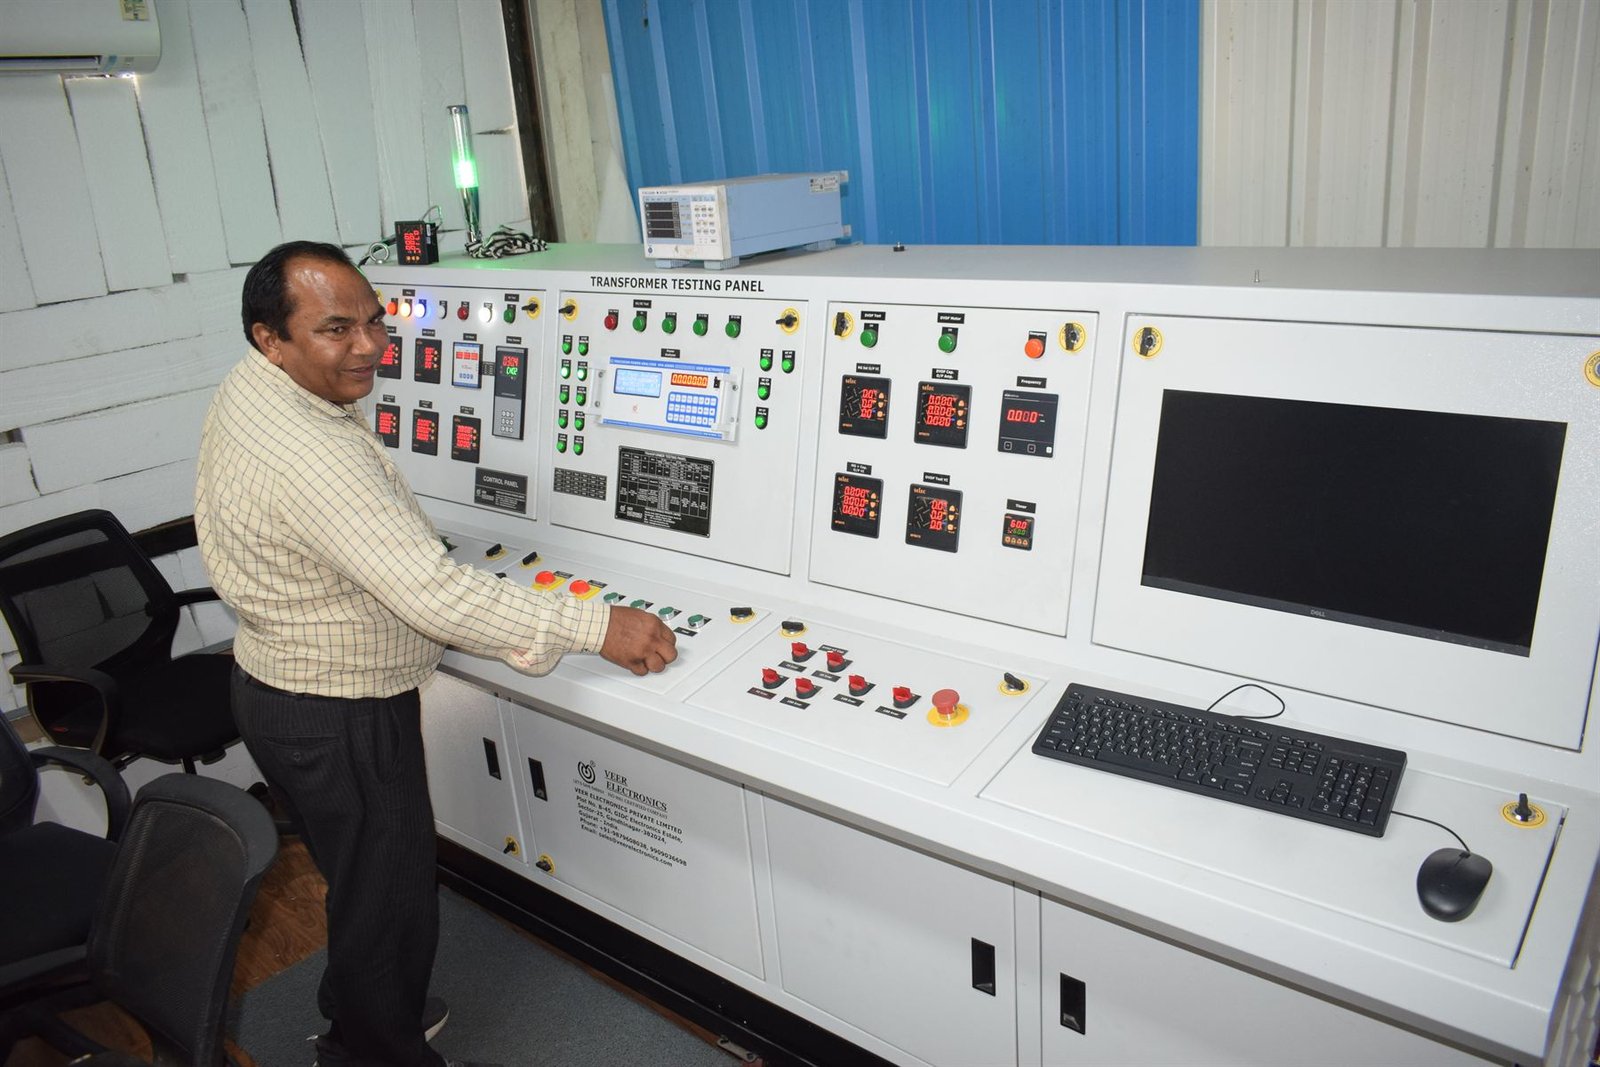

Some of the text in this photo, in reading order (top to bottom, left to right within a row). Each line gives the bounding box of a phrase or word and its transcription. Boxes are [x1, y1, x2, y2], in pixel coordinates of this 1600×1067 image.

[590, 276, 765, 293] TRANSFORMER TESTING PANEL
[483, 475, 519, 488] CONTROL PANEL
[604, 769, 628, 785] VEER
[606, 780, 667, 811] ELECTRONICS
[574, 787, 682, 835] VEER ELECTRONICS PRIVATE LIMITED
[576, 795, 587, 804] Plot
[614, 810, 629, 820] GIDC
[629, 817, 661, 834] Electronics
[662, 830, 683, 844] Estate,
[579, 810, 598, 822] Gujarat
